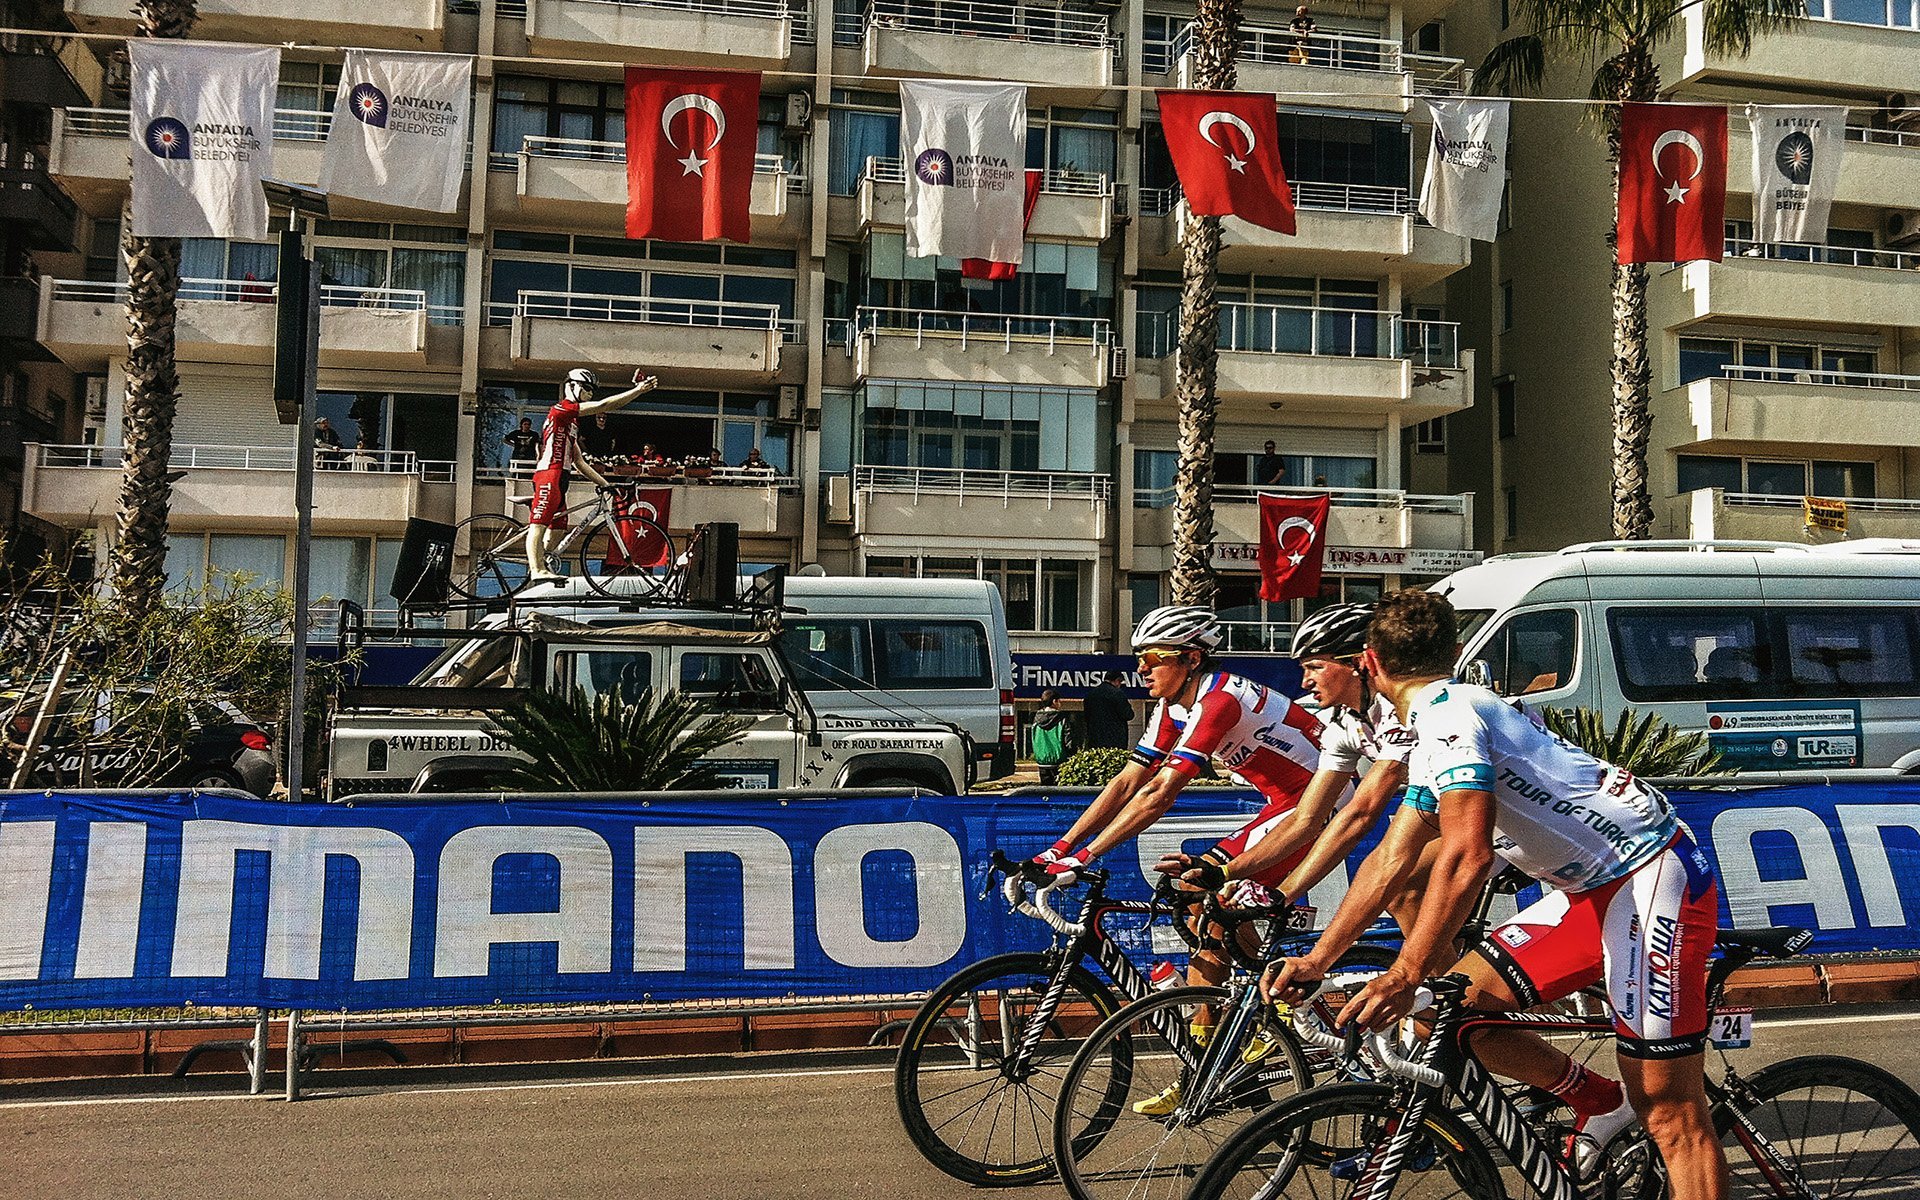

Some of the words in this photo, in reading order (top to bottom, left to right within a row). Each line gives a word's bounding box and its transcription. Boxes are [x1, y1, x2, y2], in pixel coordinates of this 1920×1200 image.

[392, 95, 454, 113] ANTALYA
[193, 123, 254, 137] ANTALYA
[1447, 140, 1492, 152] ANTALYA
[955, 155, 1008, 168] ANTALYA
[1329, 550, 1406, 566] İNŞAAT
[825, 720, 864, 728] LAND
[1723, 717, 1738, 729] 49
[388, 736, 471, 751] 4WHEEL
[832, 740, 850, 749] OFF
[852, 740, 877, 749] ROAD
[880, 740, 914, 749] SAFARI
[916, 740, 944, 749] TEAM
[1800, 740, 1831, 756] TUR
[820, 750, 834, 762] 4
[1498, 767, 1551, 806] TOUR
[1552, 799, 1584, 817] OF
[1583, 809, 1637, 855] TURKE
[0, 820, 968, 980] IMANO
[1291, 911, 1308, 929] 26
[1721, 1015, 1742, 1040] 24
[1649, 1042, 1692, 1053] CANYON
[1258, 1068, 1293, 1081] SHIMA
